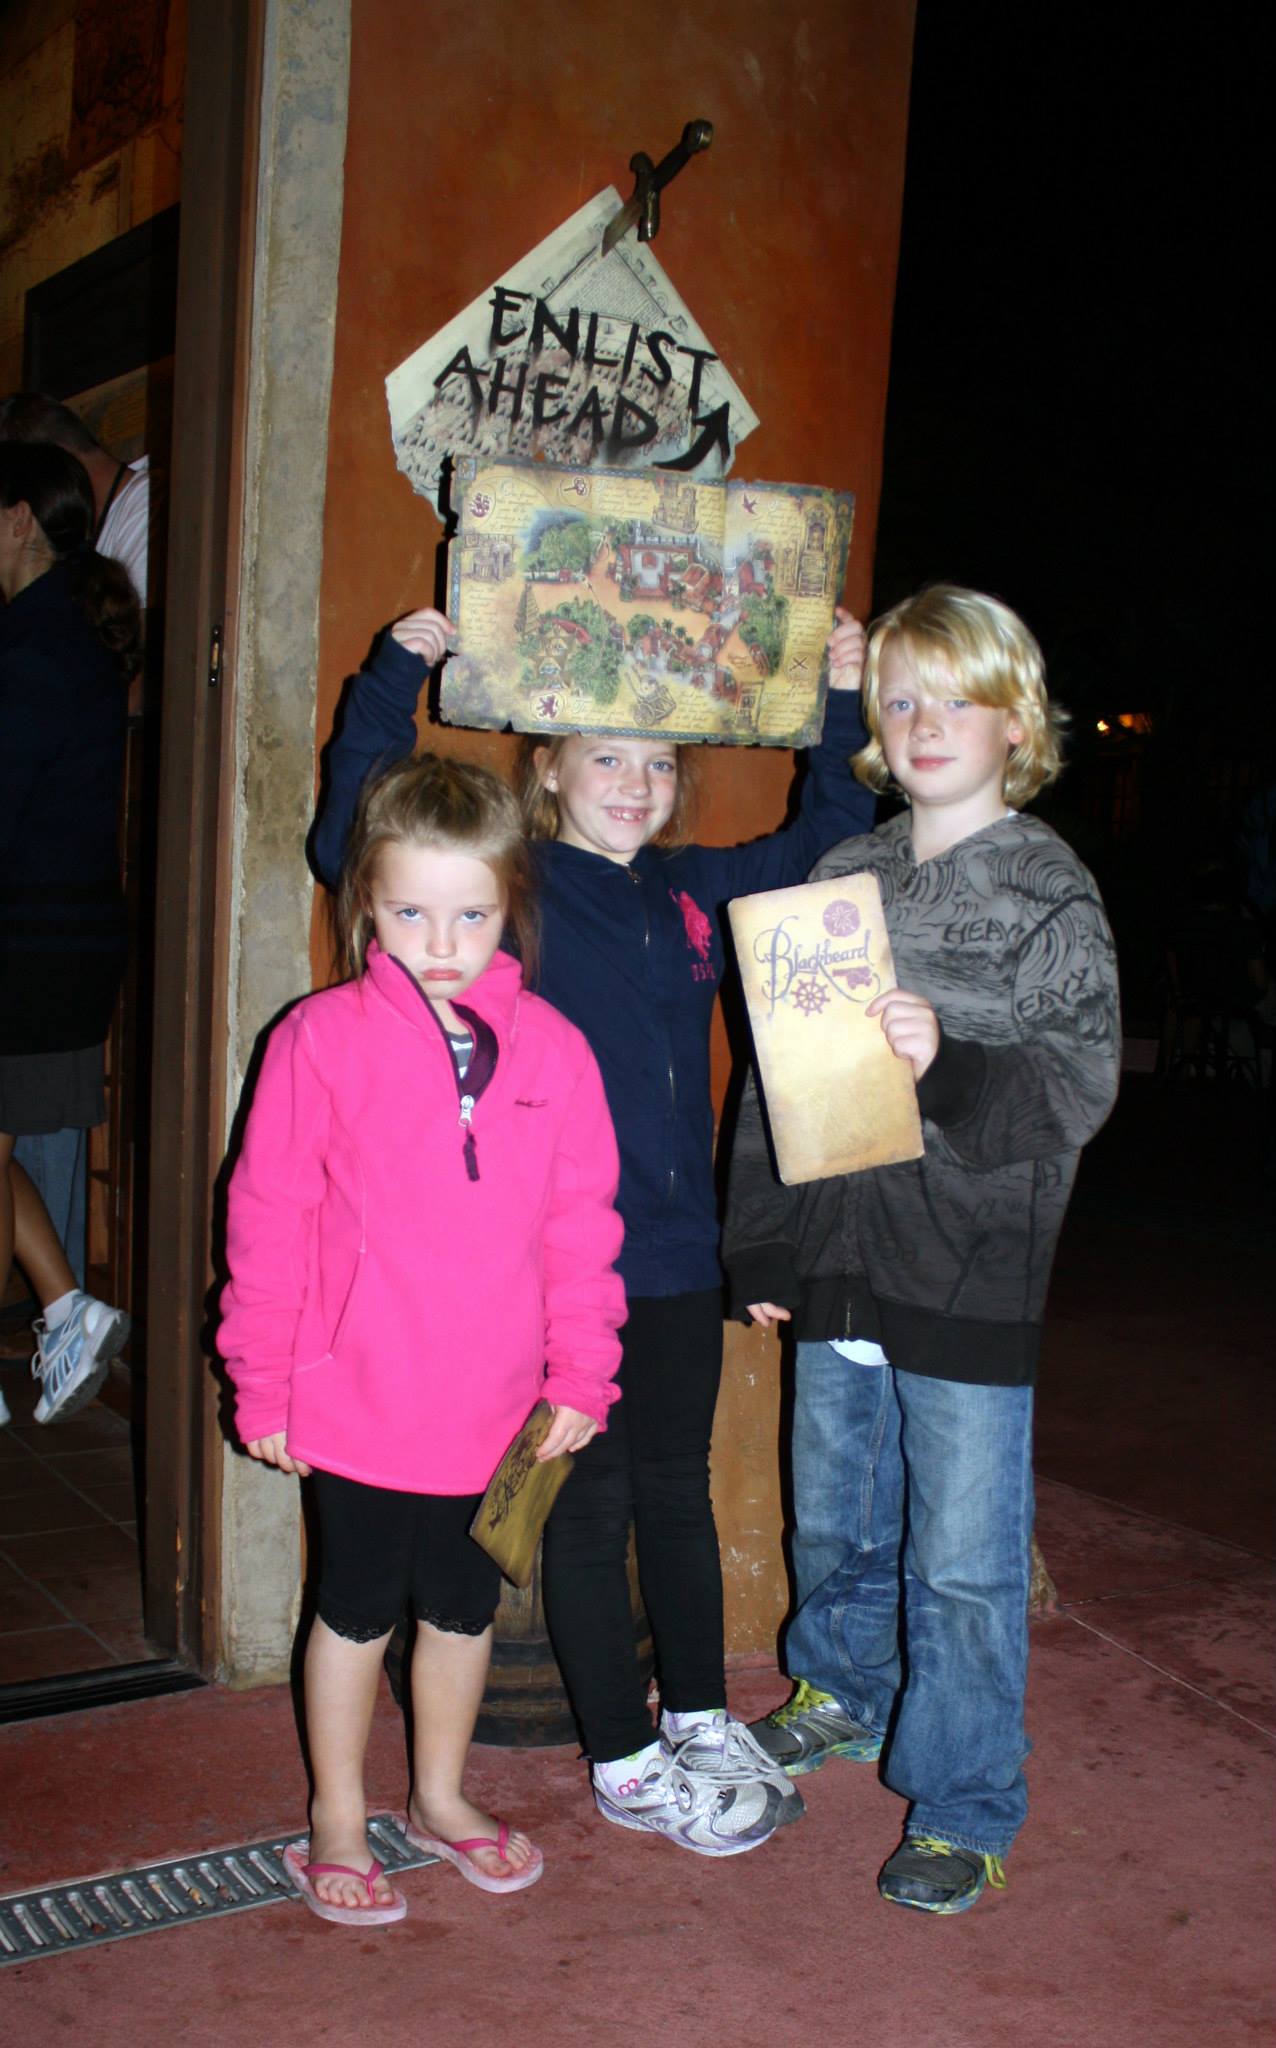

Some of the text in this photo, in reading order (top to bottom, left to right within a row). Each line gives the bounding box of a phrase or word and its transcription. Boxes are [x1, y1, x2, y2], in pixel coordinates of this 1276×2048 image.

[433, 345, 659, 447] AHEAD
[489, 286, 718, 415] ENLIST
[753, 915, 880, 1019] Blackbeard
